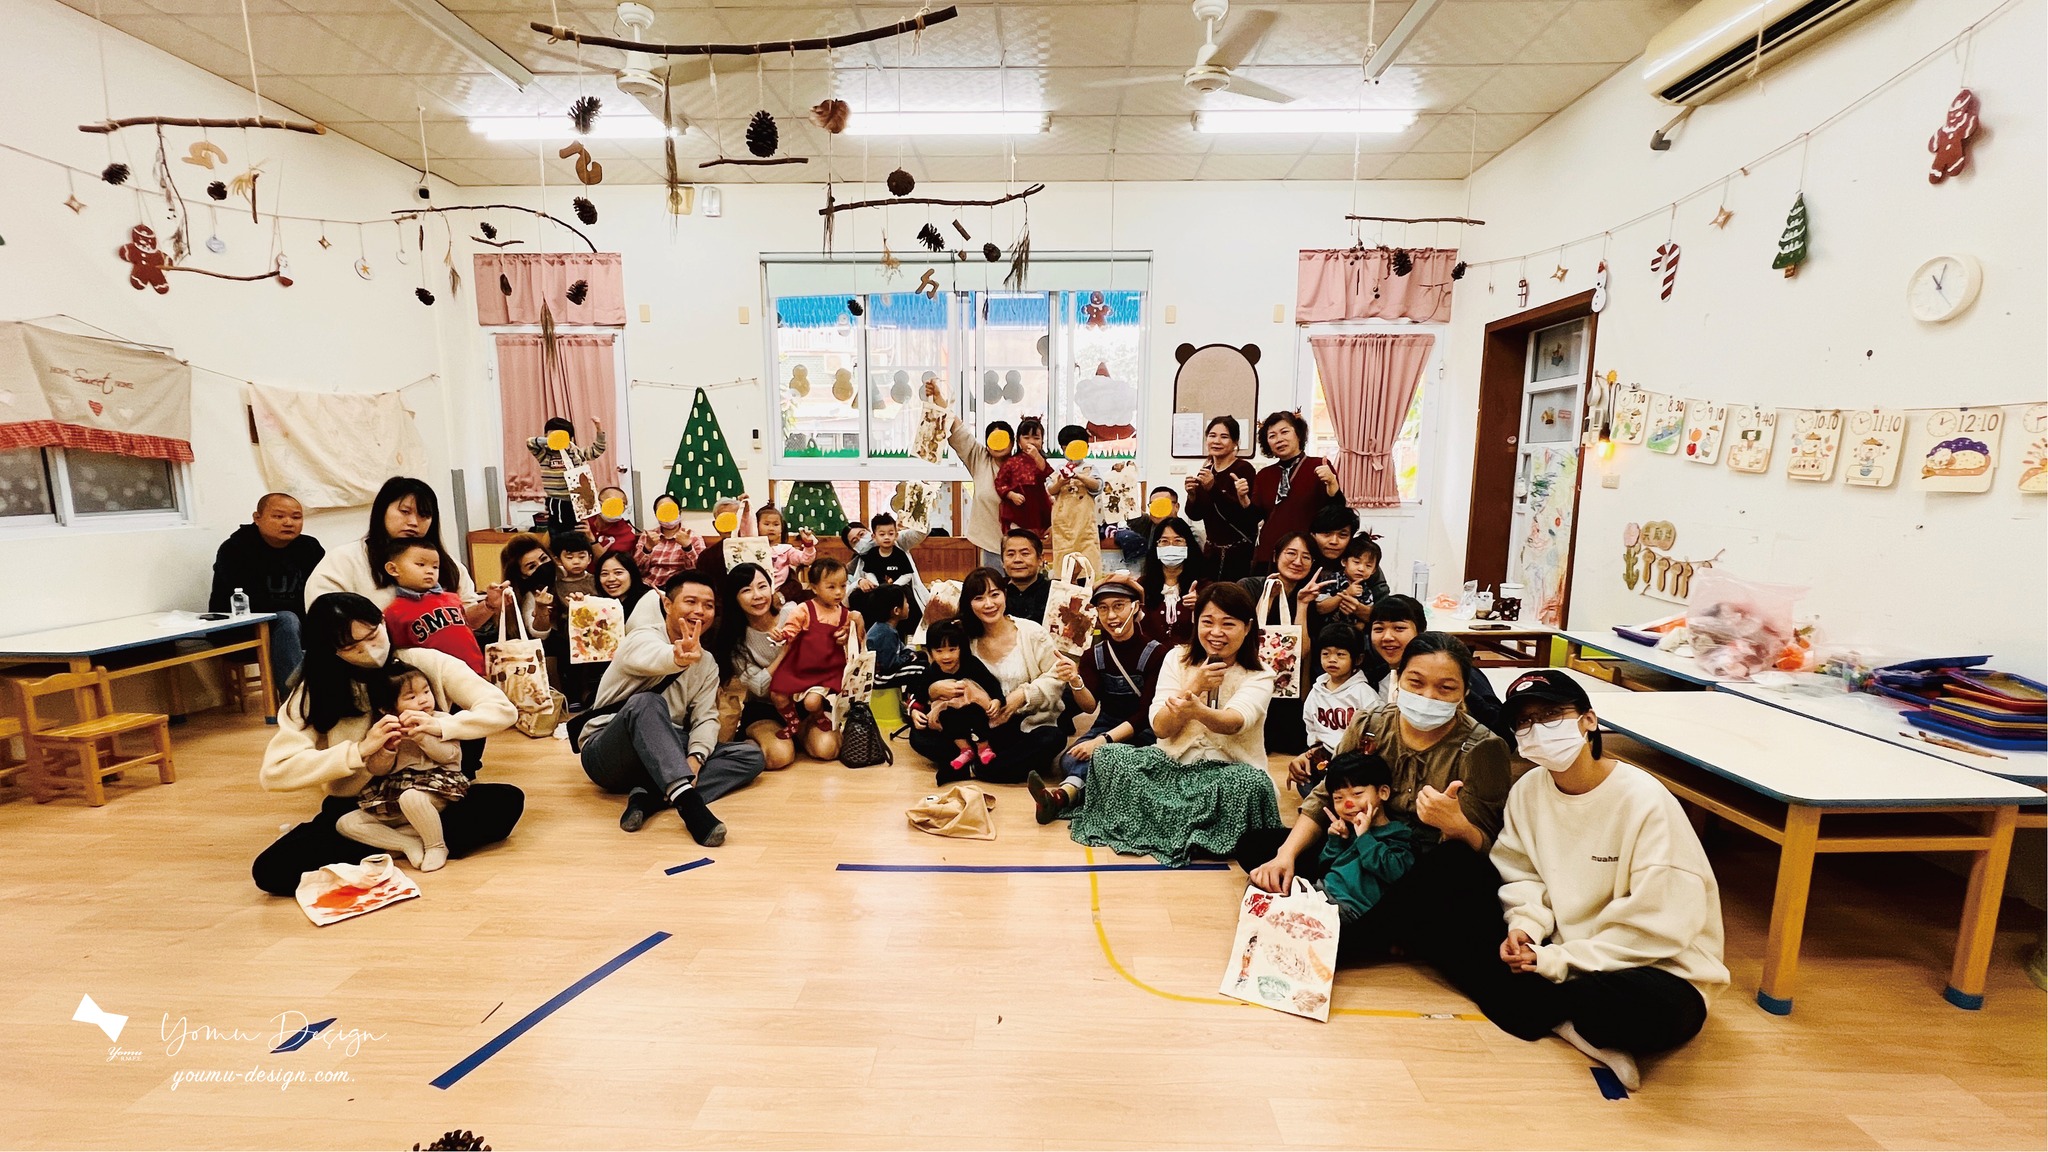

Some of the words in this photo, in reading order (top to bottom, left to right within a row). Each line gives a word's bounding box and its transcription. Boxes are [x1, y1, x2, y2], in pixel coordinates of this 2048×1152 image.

[1632, 393, 1646, 404] 730
[1667, 399, 1684, 413] 830
[1708, 406, 1725, 421] 910
[1754, 411, 1775, 427] 9:40
[1813, 413, 1839, 430] 10:10
[1872, 415, 1901, 432] 11:10
[1957, 413, 1999, 433] 12:10
[411, 606, 466, 644] SME
